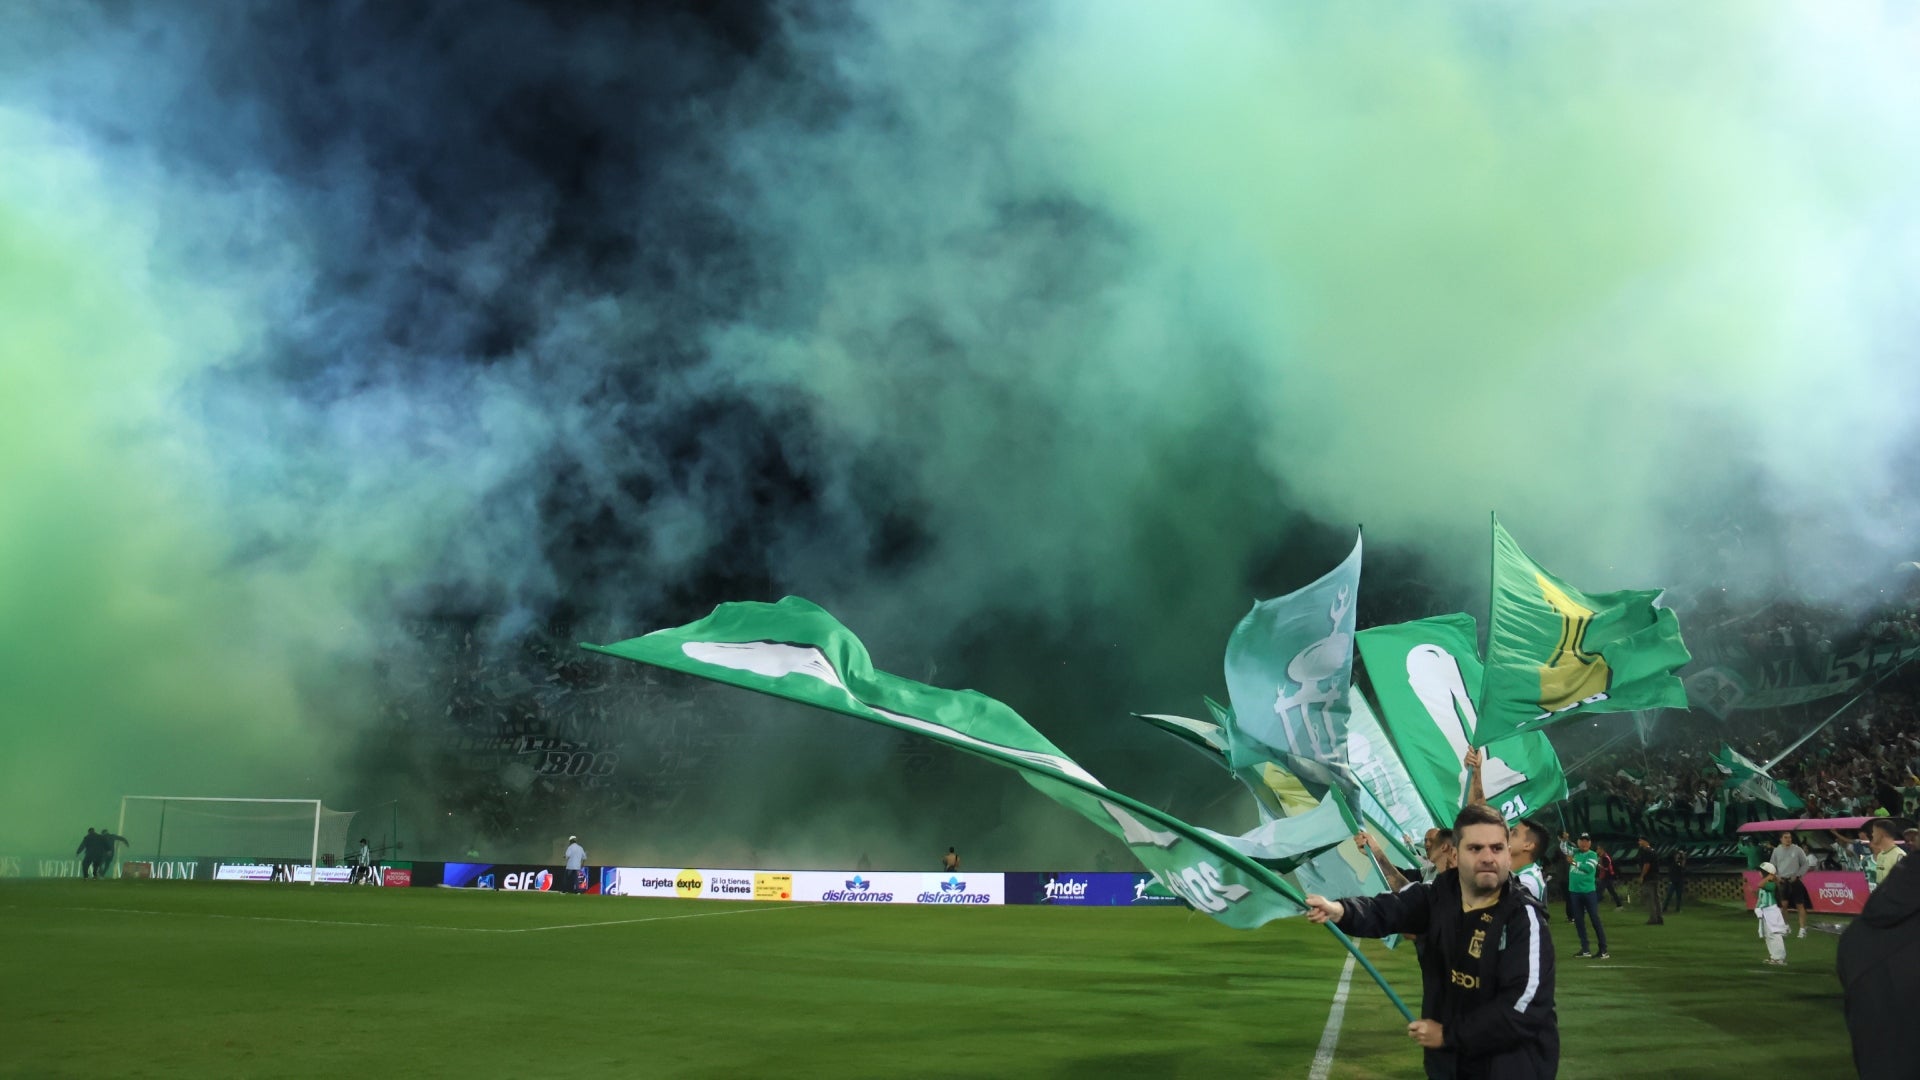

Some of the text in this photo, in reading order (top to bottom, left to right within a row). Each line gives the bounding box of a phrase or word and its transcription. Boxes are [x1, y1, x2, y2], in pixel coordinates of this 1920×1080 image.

[504, 872, 535, 890] elf
[642, 878, 702, 891] tarjeta éxito
[711, 884, 751, 893] lo tienes
[822, 890, 893, 902] disfraromas
[917, 892, 990, 904] disfraromas
